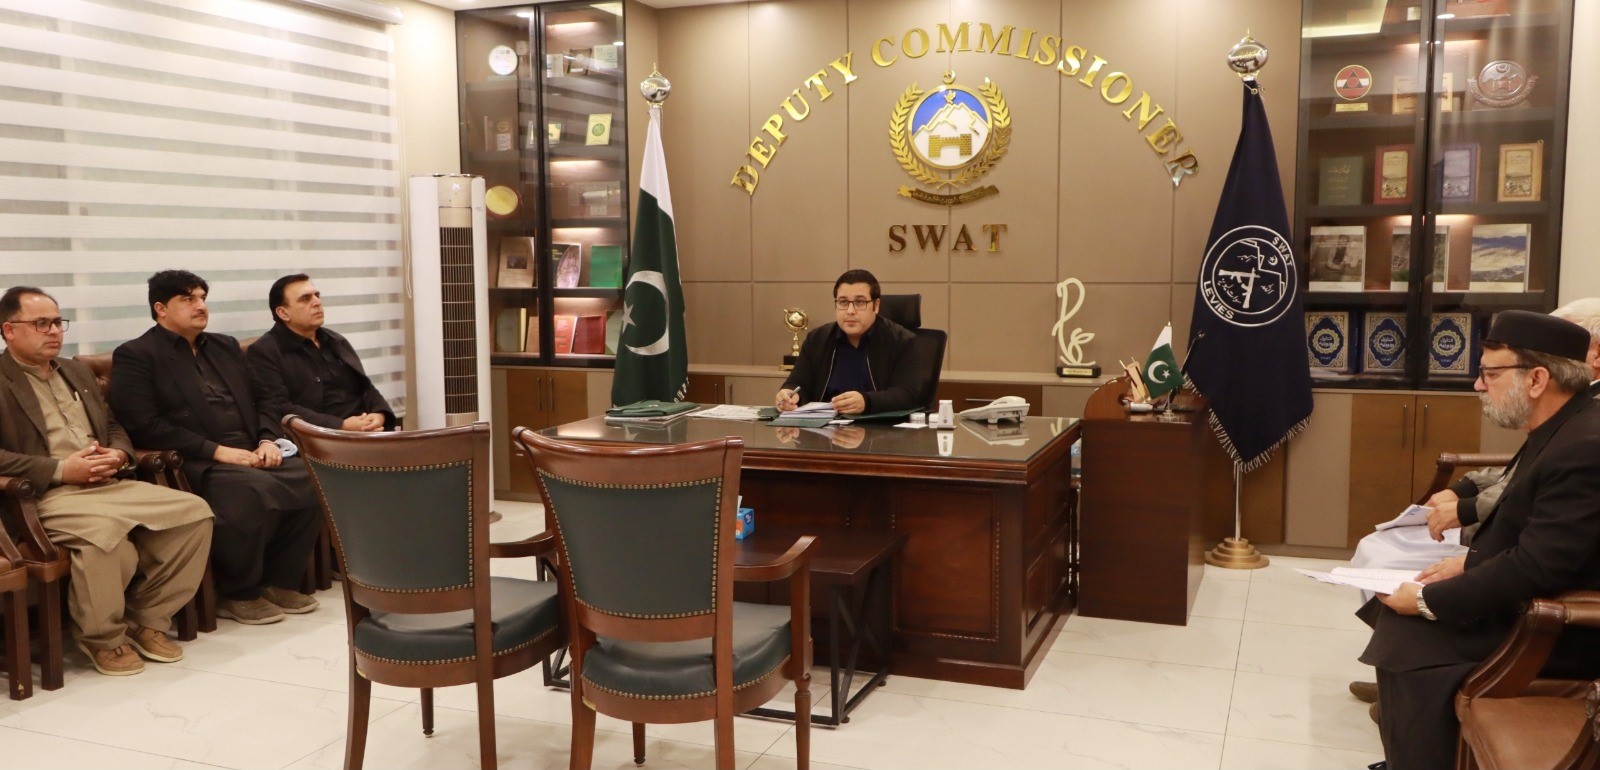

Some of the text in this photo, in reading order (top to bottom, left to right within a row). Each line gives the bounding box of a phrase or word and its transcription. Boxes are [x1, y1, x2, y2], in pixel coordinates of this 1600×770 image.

[730, 22, 1199, 196] DEPUTY COMMISSIONER
[888, 223, 1008, 252] SWAT
[1272, 236, 1293, 267] SWAT
[1203, 280, 1235, 319] LEVIES
